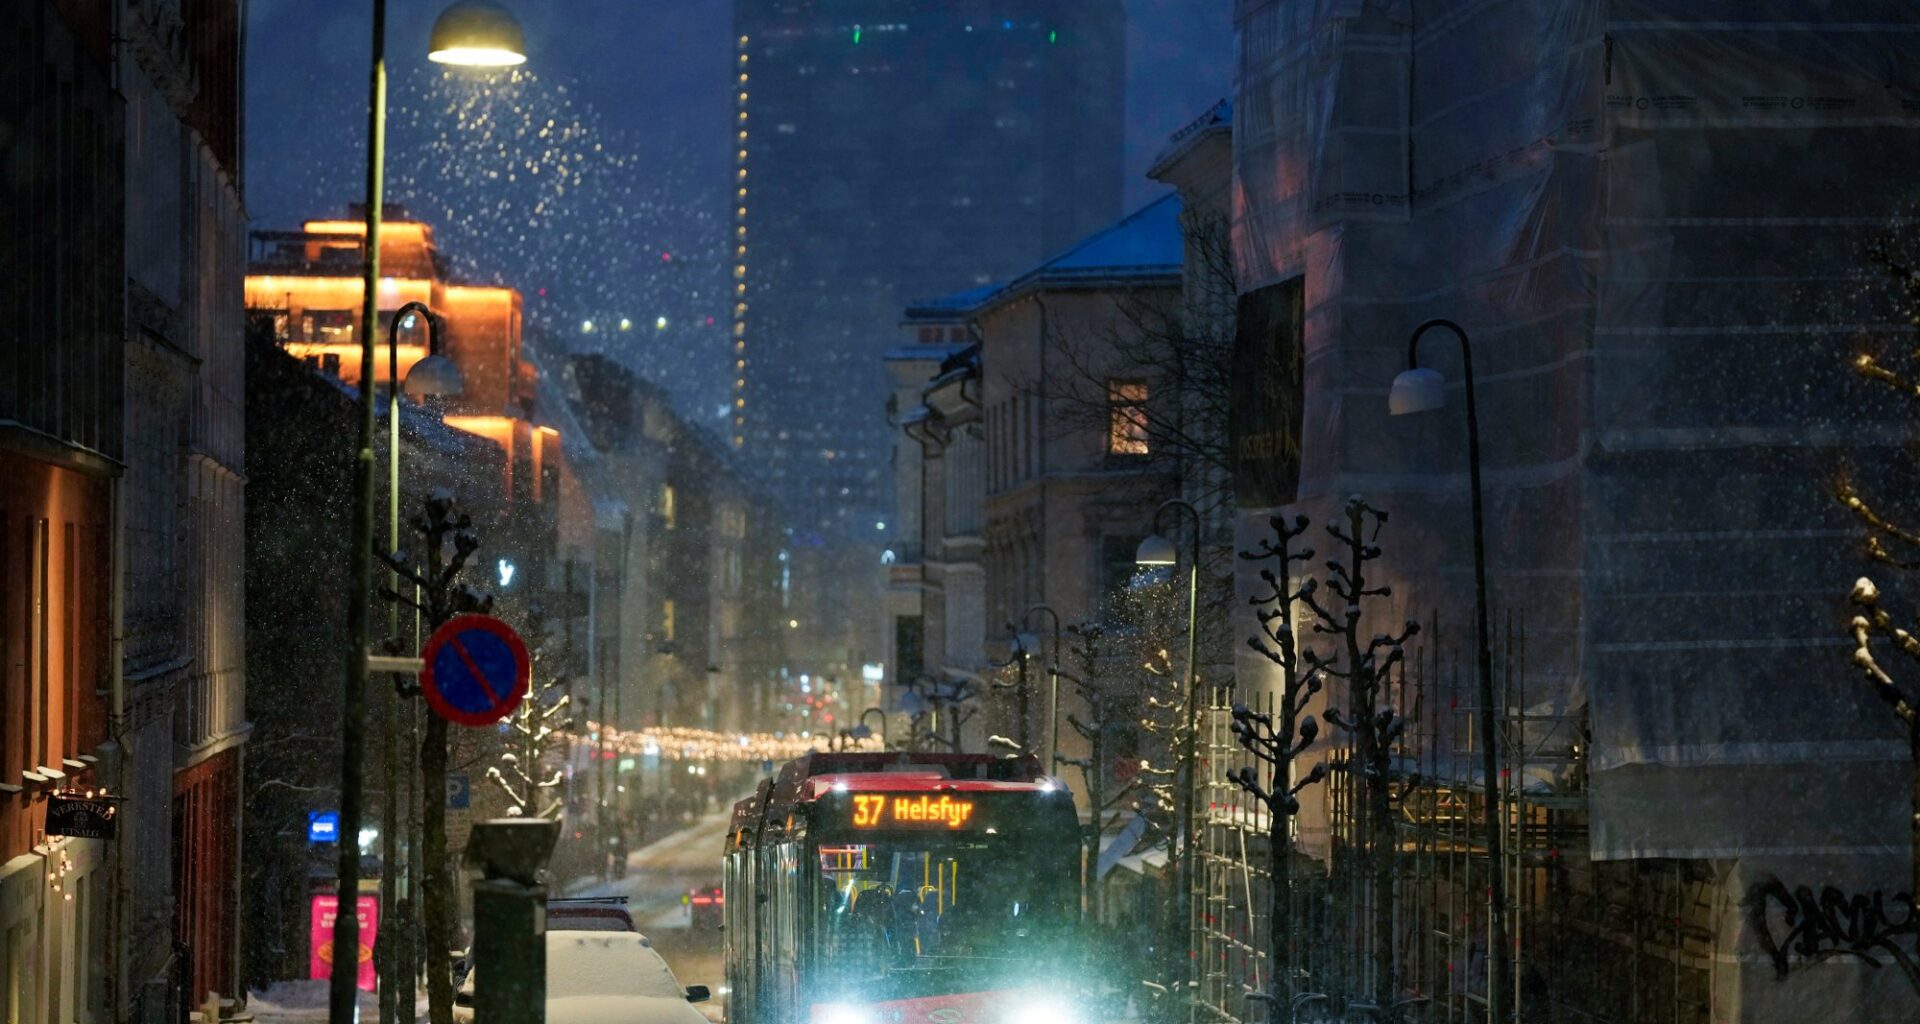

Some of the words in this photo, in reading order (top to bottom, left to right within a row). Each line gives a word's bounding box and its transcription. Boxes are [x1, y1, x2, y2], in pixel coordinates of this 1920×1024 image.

[51, 801, 112, 821] VERKSTED
[853, 795, 884, 826] 37
[894, 795, 972, 827] Helsfyr
